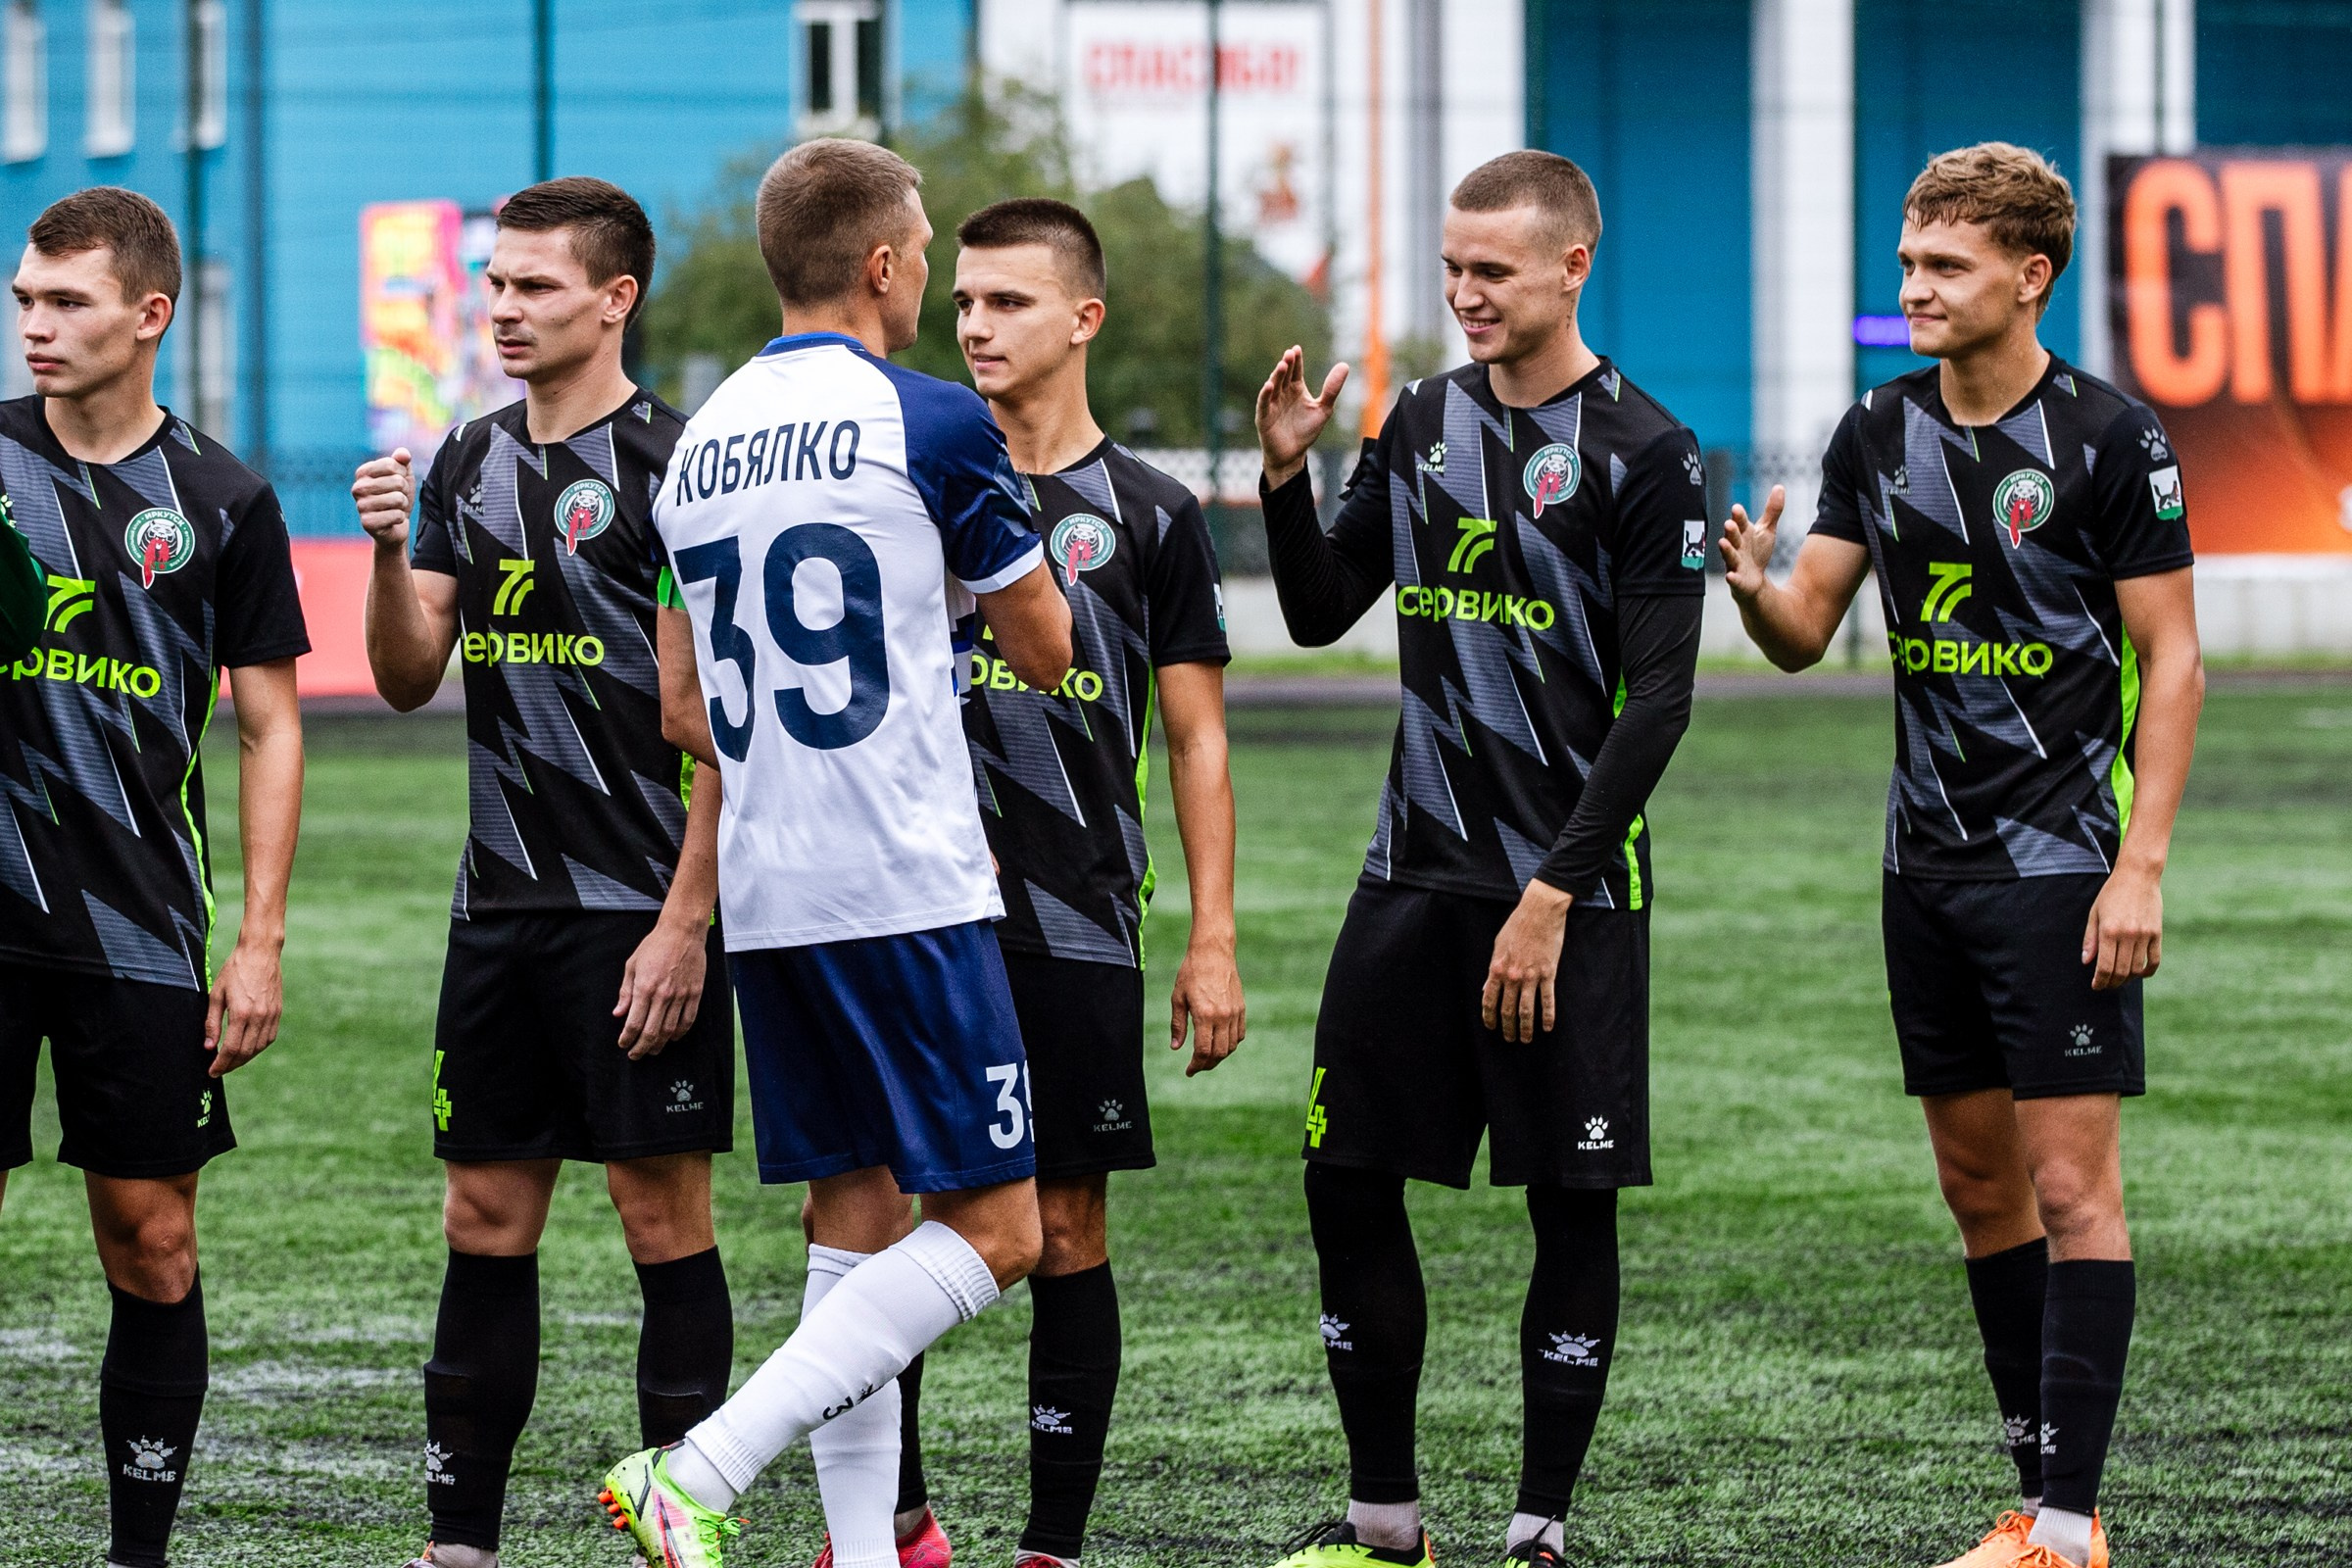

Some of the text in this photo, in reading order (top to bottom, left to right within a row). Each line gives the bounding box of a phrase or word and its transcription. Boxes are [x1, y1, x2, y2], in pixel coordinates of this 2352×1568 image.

[2123, 158, 2352, 408] СП
[676, 419, 860, 508] КОБЯЛКО
[573, 482, 608, 497] ИРКУТСК
[144, 511, 185, 527] ИРКУТСК
[1068, 516, 1106, 530] ИРКУТСК
[461, 631, 605, 667] ервико
[673, 522, 891, 763] 39
[0, 646, 162, 699] рвико
[2064, 1045, 2103, 1057] KELME
[665, 1102, 705, 1113] KELME
[985, 1058, 1036, 1150] 3
[197, 1113, 211, 1128] KEL
[1093, 1120, 1133, 1133] KELME
[1578, 1139, 1615, 1151] KELME
[1543, 1349, 1598, 1367] KELME
[122, 1463, 177, 1483] KELME
